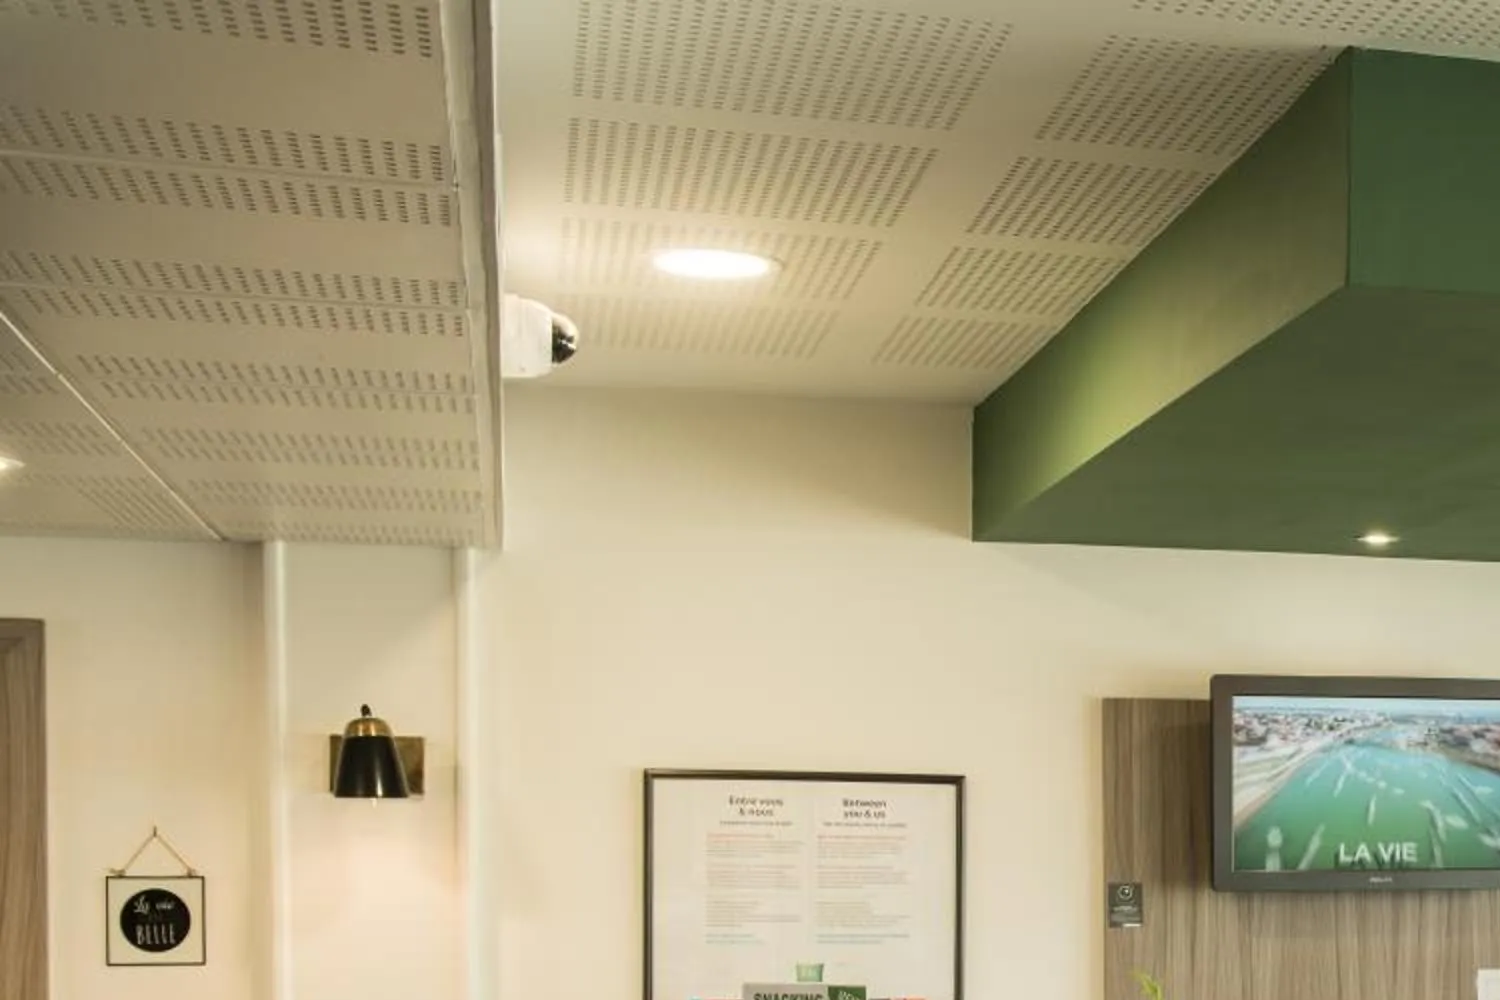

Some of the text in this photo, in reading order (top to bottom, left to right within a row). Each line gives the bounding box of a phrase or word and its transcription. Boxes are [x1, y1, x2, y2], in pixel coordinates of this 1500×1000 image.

[842, 797, 887, 808] Between
[1338, 841, 1418, 862] LA VIE
